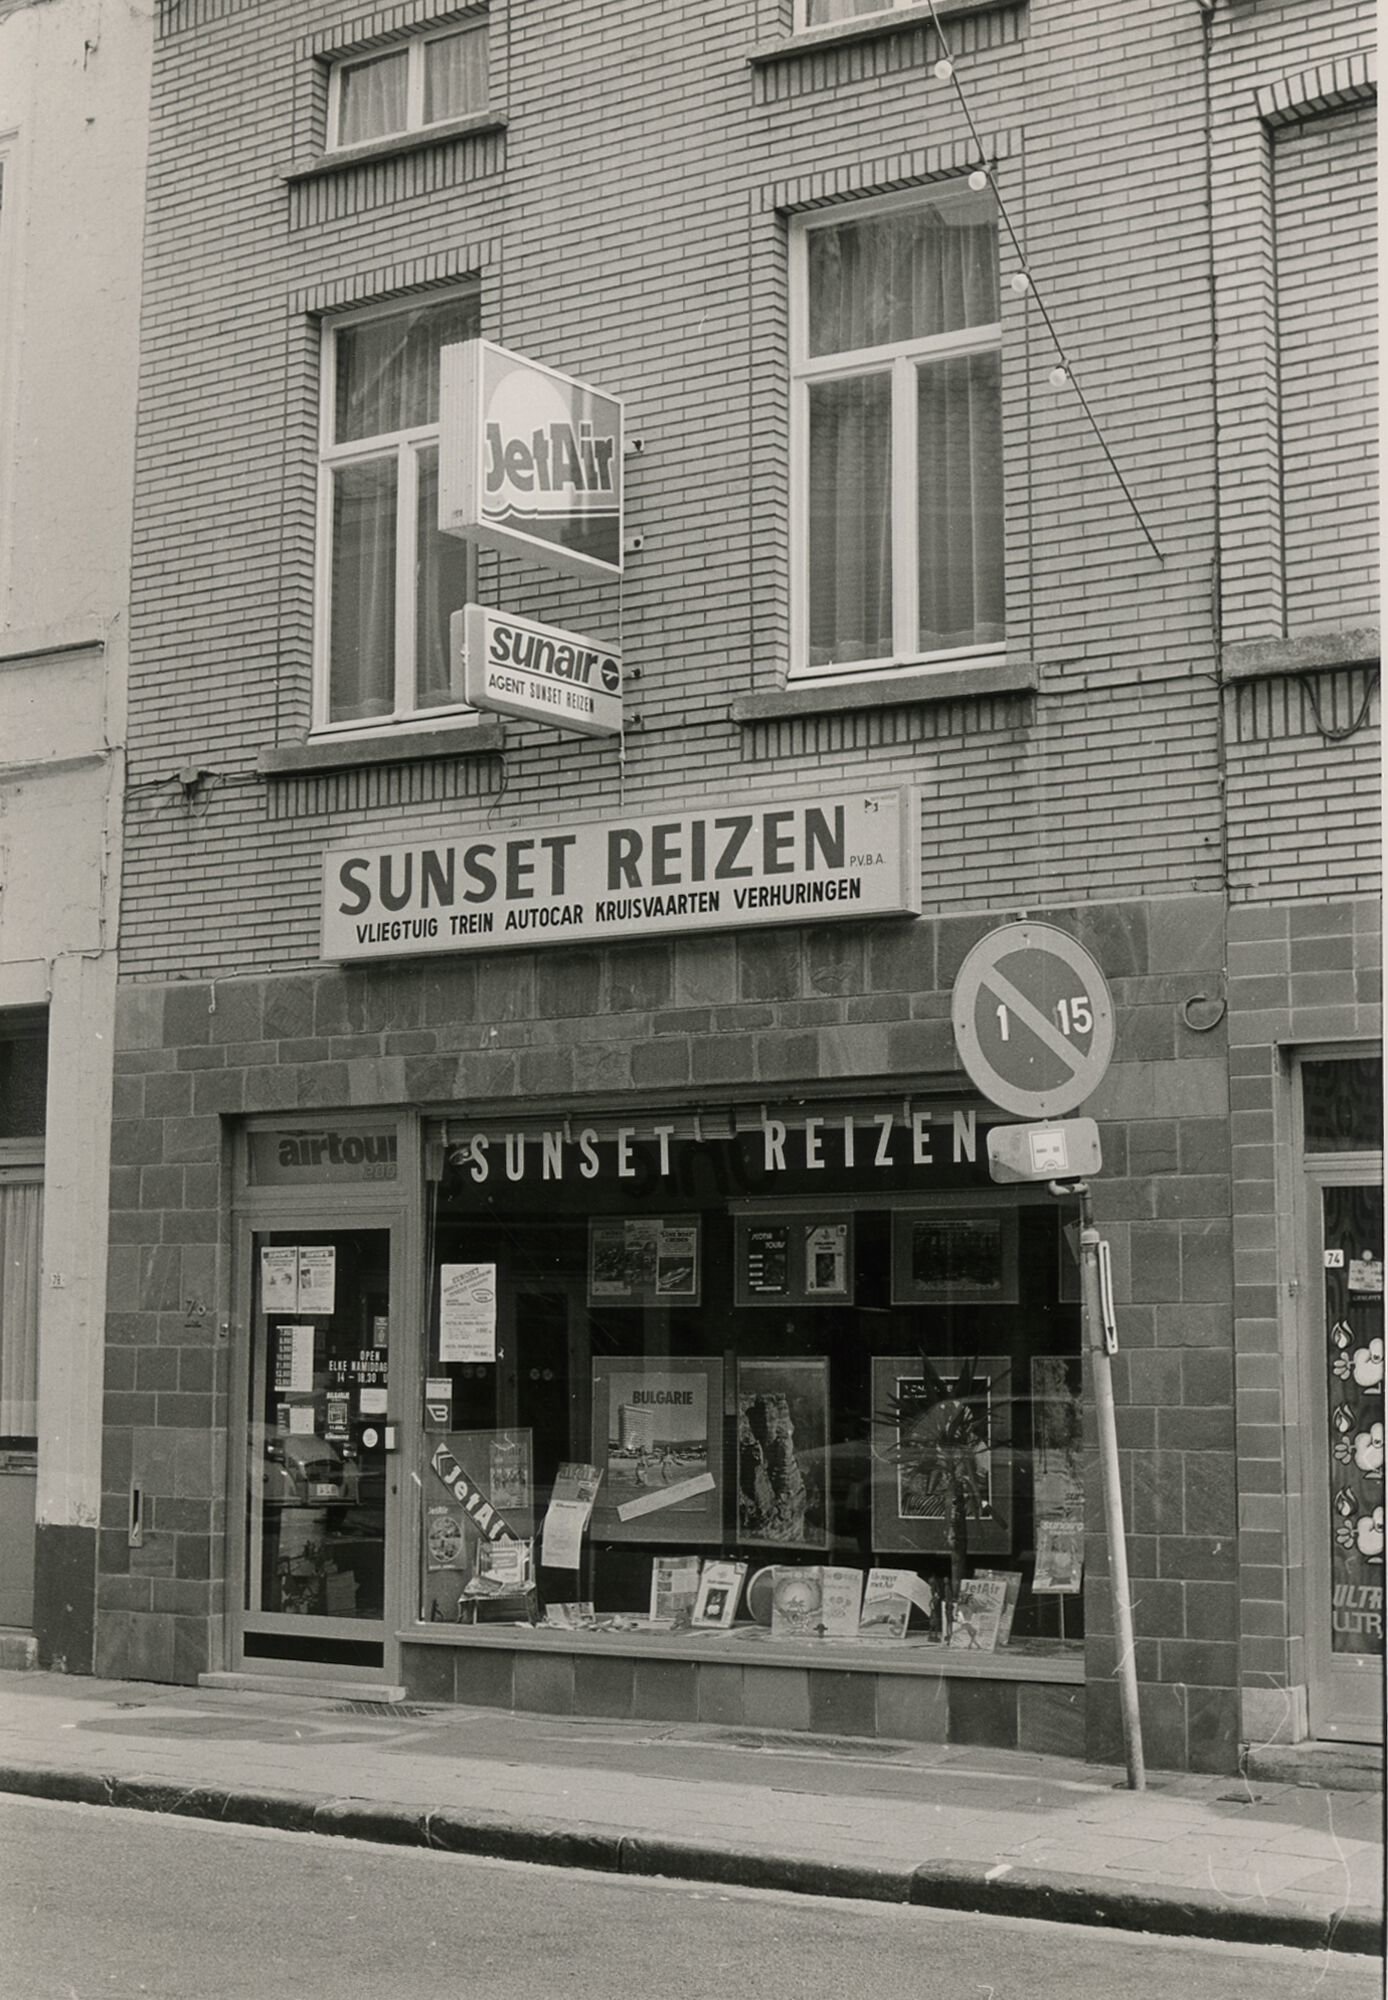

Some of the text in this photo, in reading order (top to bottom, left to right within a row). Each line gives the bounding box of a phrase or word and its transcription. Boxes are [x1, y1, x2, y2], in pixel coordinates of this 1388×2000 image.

[485, 421, 613, 492] JetAir
[489, 626, 598, 684] sunair
[488, 673, 595, 714] AGENT SUNSET REIZEN
[338, 834, 578, 917] SUNSET
[606, 804, 846, 891] REIZEN
[355, 877, 861, 944] VLIEGTUIG TREIN AUTOCAR KRUISVAARTEN VERHURINGEN
[995, 1003, 1009, 1041] 1
[1055, 996, 1093, 1036] 15
[469, 1110, 977, 1183] SUNSET REIZEN
[328, 1360, 348, 1371] ELKE
[360, 1350, 380, 1361] OPEN
[337, 1372, 345, 1383] 14
[632, 1390, 693, 1406] BULGARIE
[963, 1581, 1001, 1595] JetAir
